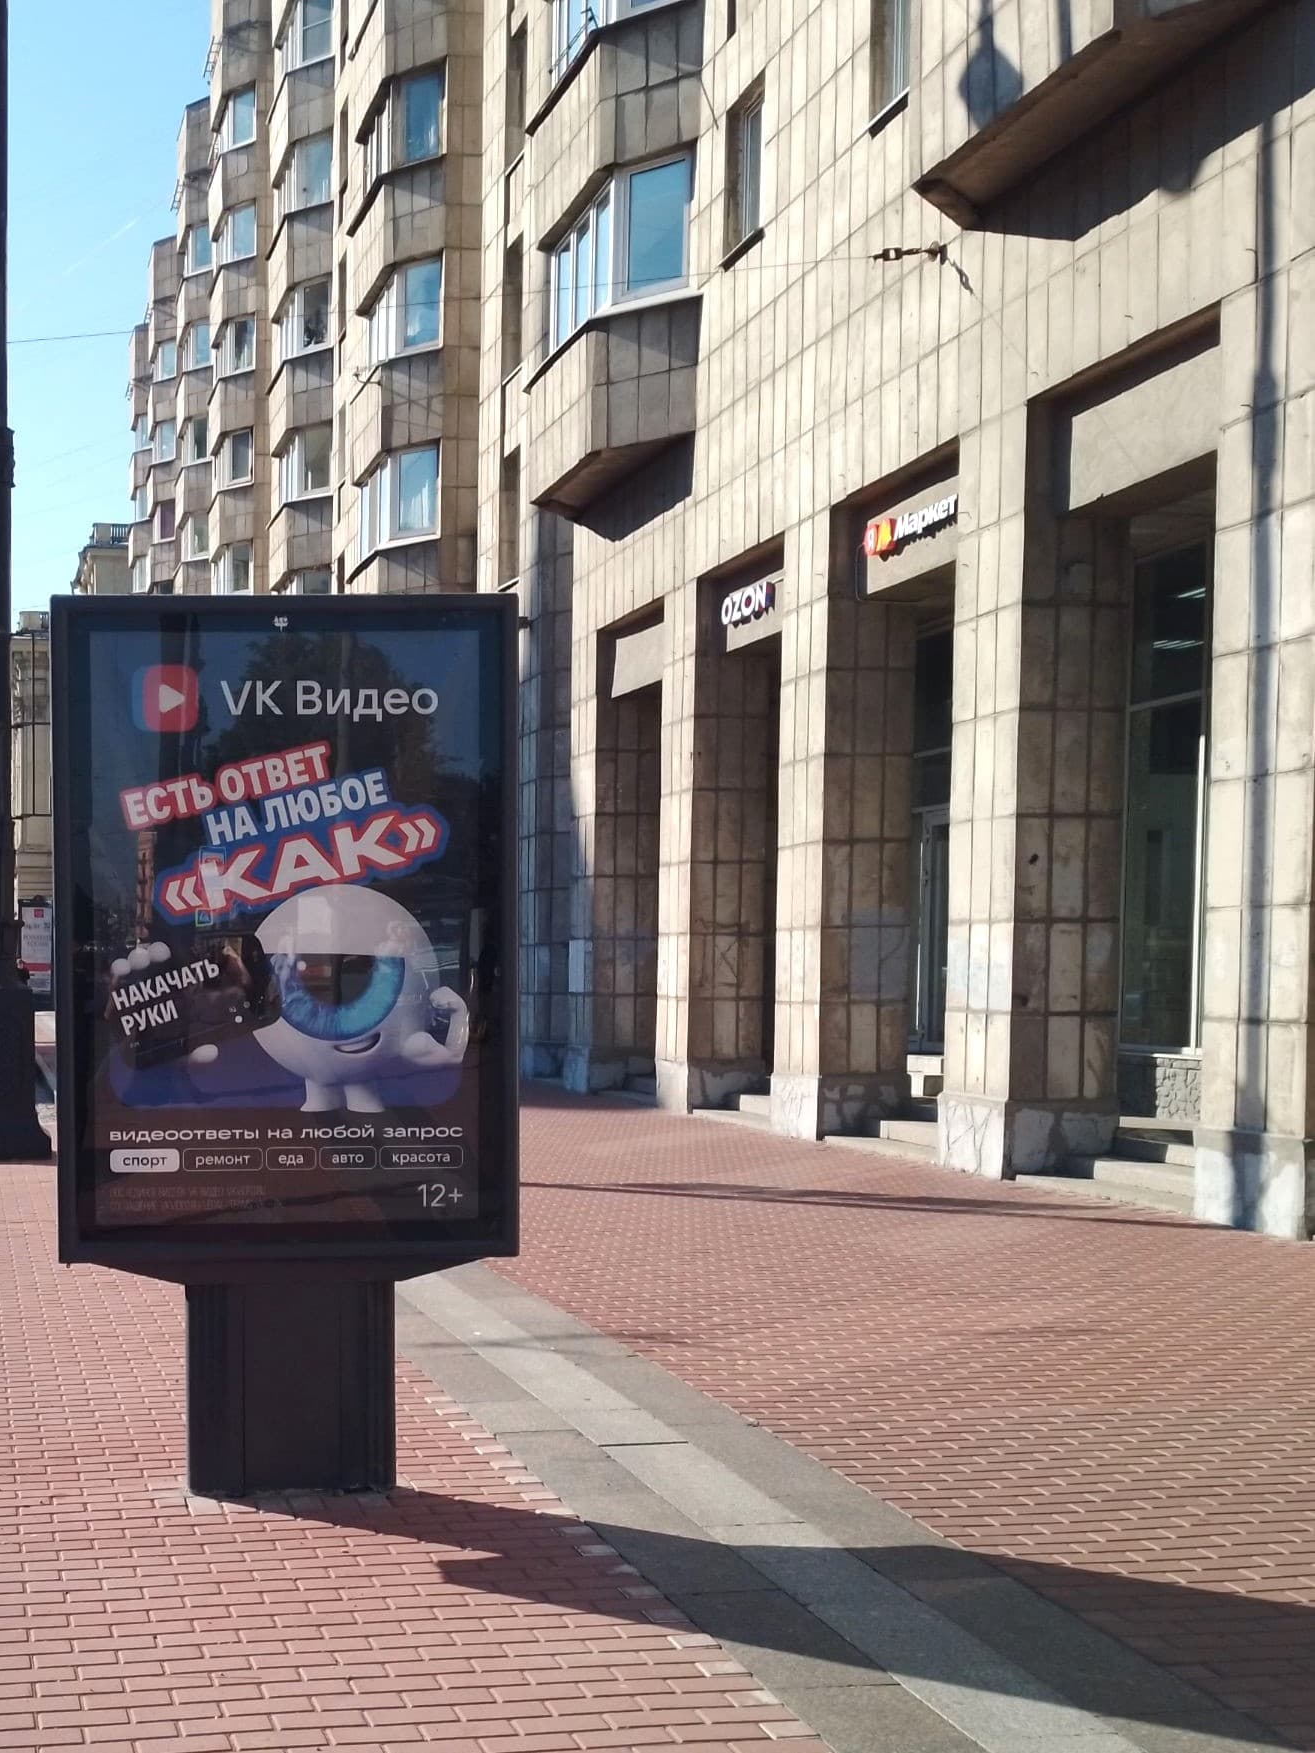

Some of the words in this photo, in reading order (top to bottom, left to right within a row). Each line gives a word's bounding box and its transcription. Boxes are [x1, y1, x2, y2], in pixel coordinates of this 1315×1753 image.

[893, 493, 958, 541] Маркет
[721, 581, 767, 625] OZON
[220, 680, 283, 715] VK
[296, 680, 439, 722] Видео
[124, 778, 214, 825] ЕСТЬ
[219, 745, 327, 801] ОТВЕТ
[206, 808, 258, 845] НА
[264, 770, 389, 833] ЛЮБОЕ
[165, 815, 437, 912] «КАК»
[111, 957, 220, 1011] НАКАЧАТЬ
[120, 1000, 179, 1036] РУКИ
[109, 1127, 260, 1143] видеоответы
[268, 1127, 293, 1139] на
[300, 1124, 375, 1139] любой
[383, 1125, 464, 1141] запрос
[122, 1154, 168, 1170] спорт
[195, 1153, 251, 1169] ремонт
[277, 1152, 304, 1166] еда
[331, 1152, 365, 1165] авто
[392, 1151, 452, 1165] красота
[417, 1183, 464, 1208] 12+
